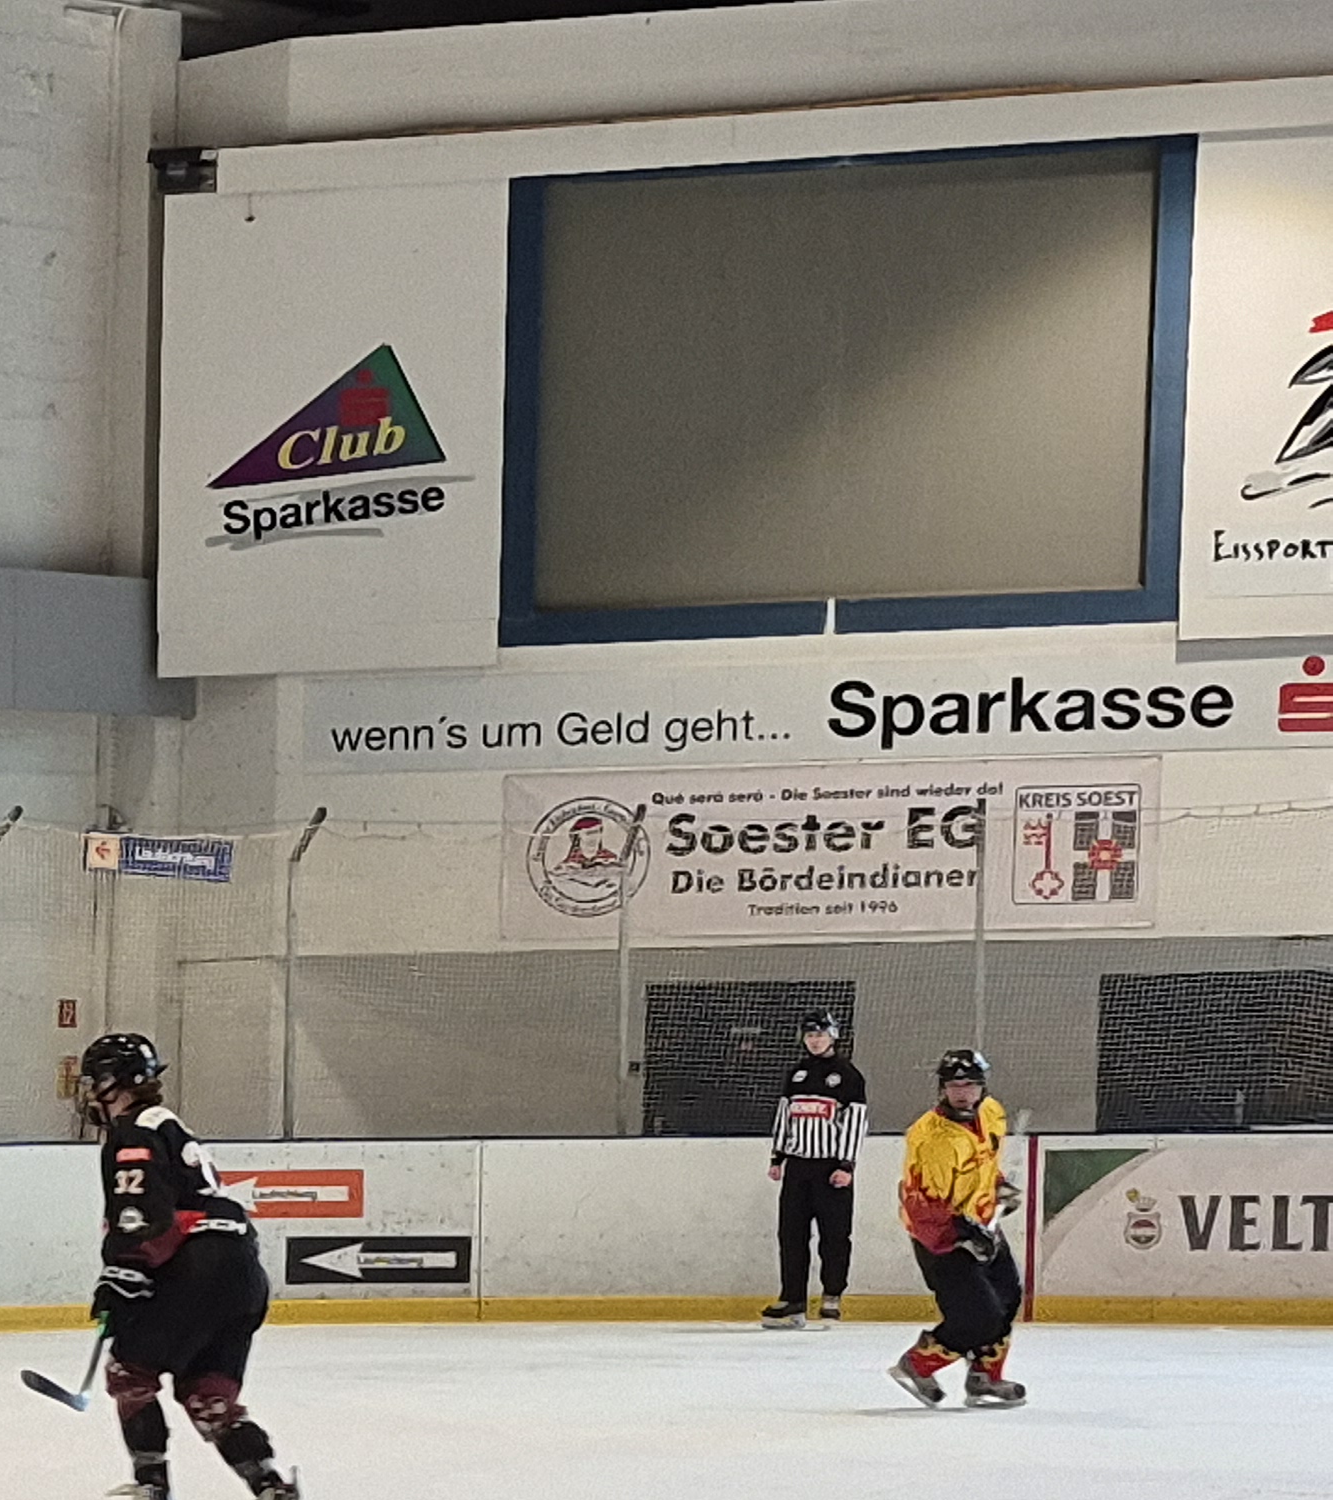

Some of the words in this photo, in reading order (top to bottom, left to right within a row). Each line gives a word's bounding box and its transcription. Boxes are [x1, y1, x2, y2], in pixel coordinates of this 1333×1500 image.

[276, 416, 407, 470] Club
[222, 485, 446, 539] Sparkasse
[482, 721, 541, 748] um
[557, 711, 650, 745] Geld
[664, 709, 791, 752] geht...
[827, 676, 1234, 750] Sparkasse
[780, 788, 808, 801] Die
[813, 786, 873, 800] Soester
[877, 784, 911, 799] sind
[916, 782, 971, 797] wieder
[1019, 792, 1072, 808] KREIS
[1076, 790, 1137, 806] SOEST
[665, 812, 885, 857] Soester
[907, 806, 983, 850] EG
[671, 869, 725, 894] Die
[737, 862, 979, 893] Bördeindianer
